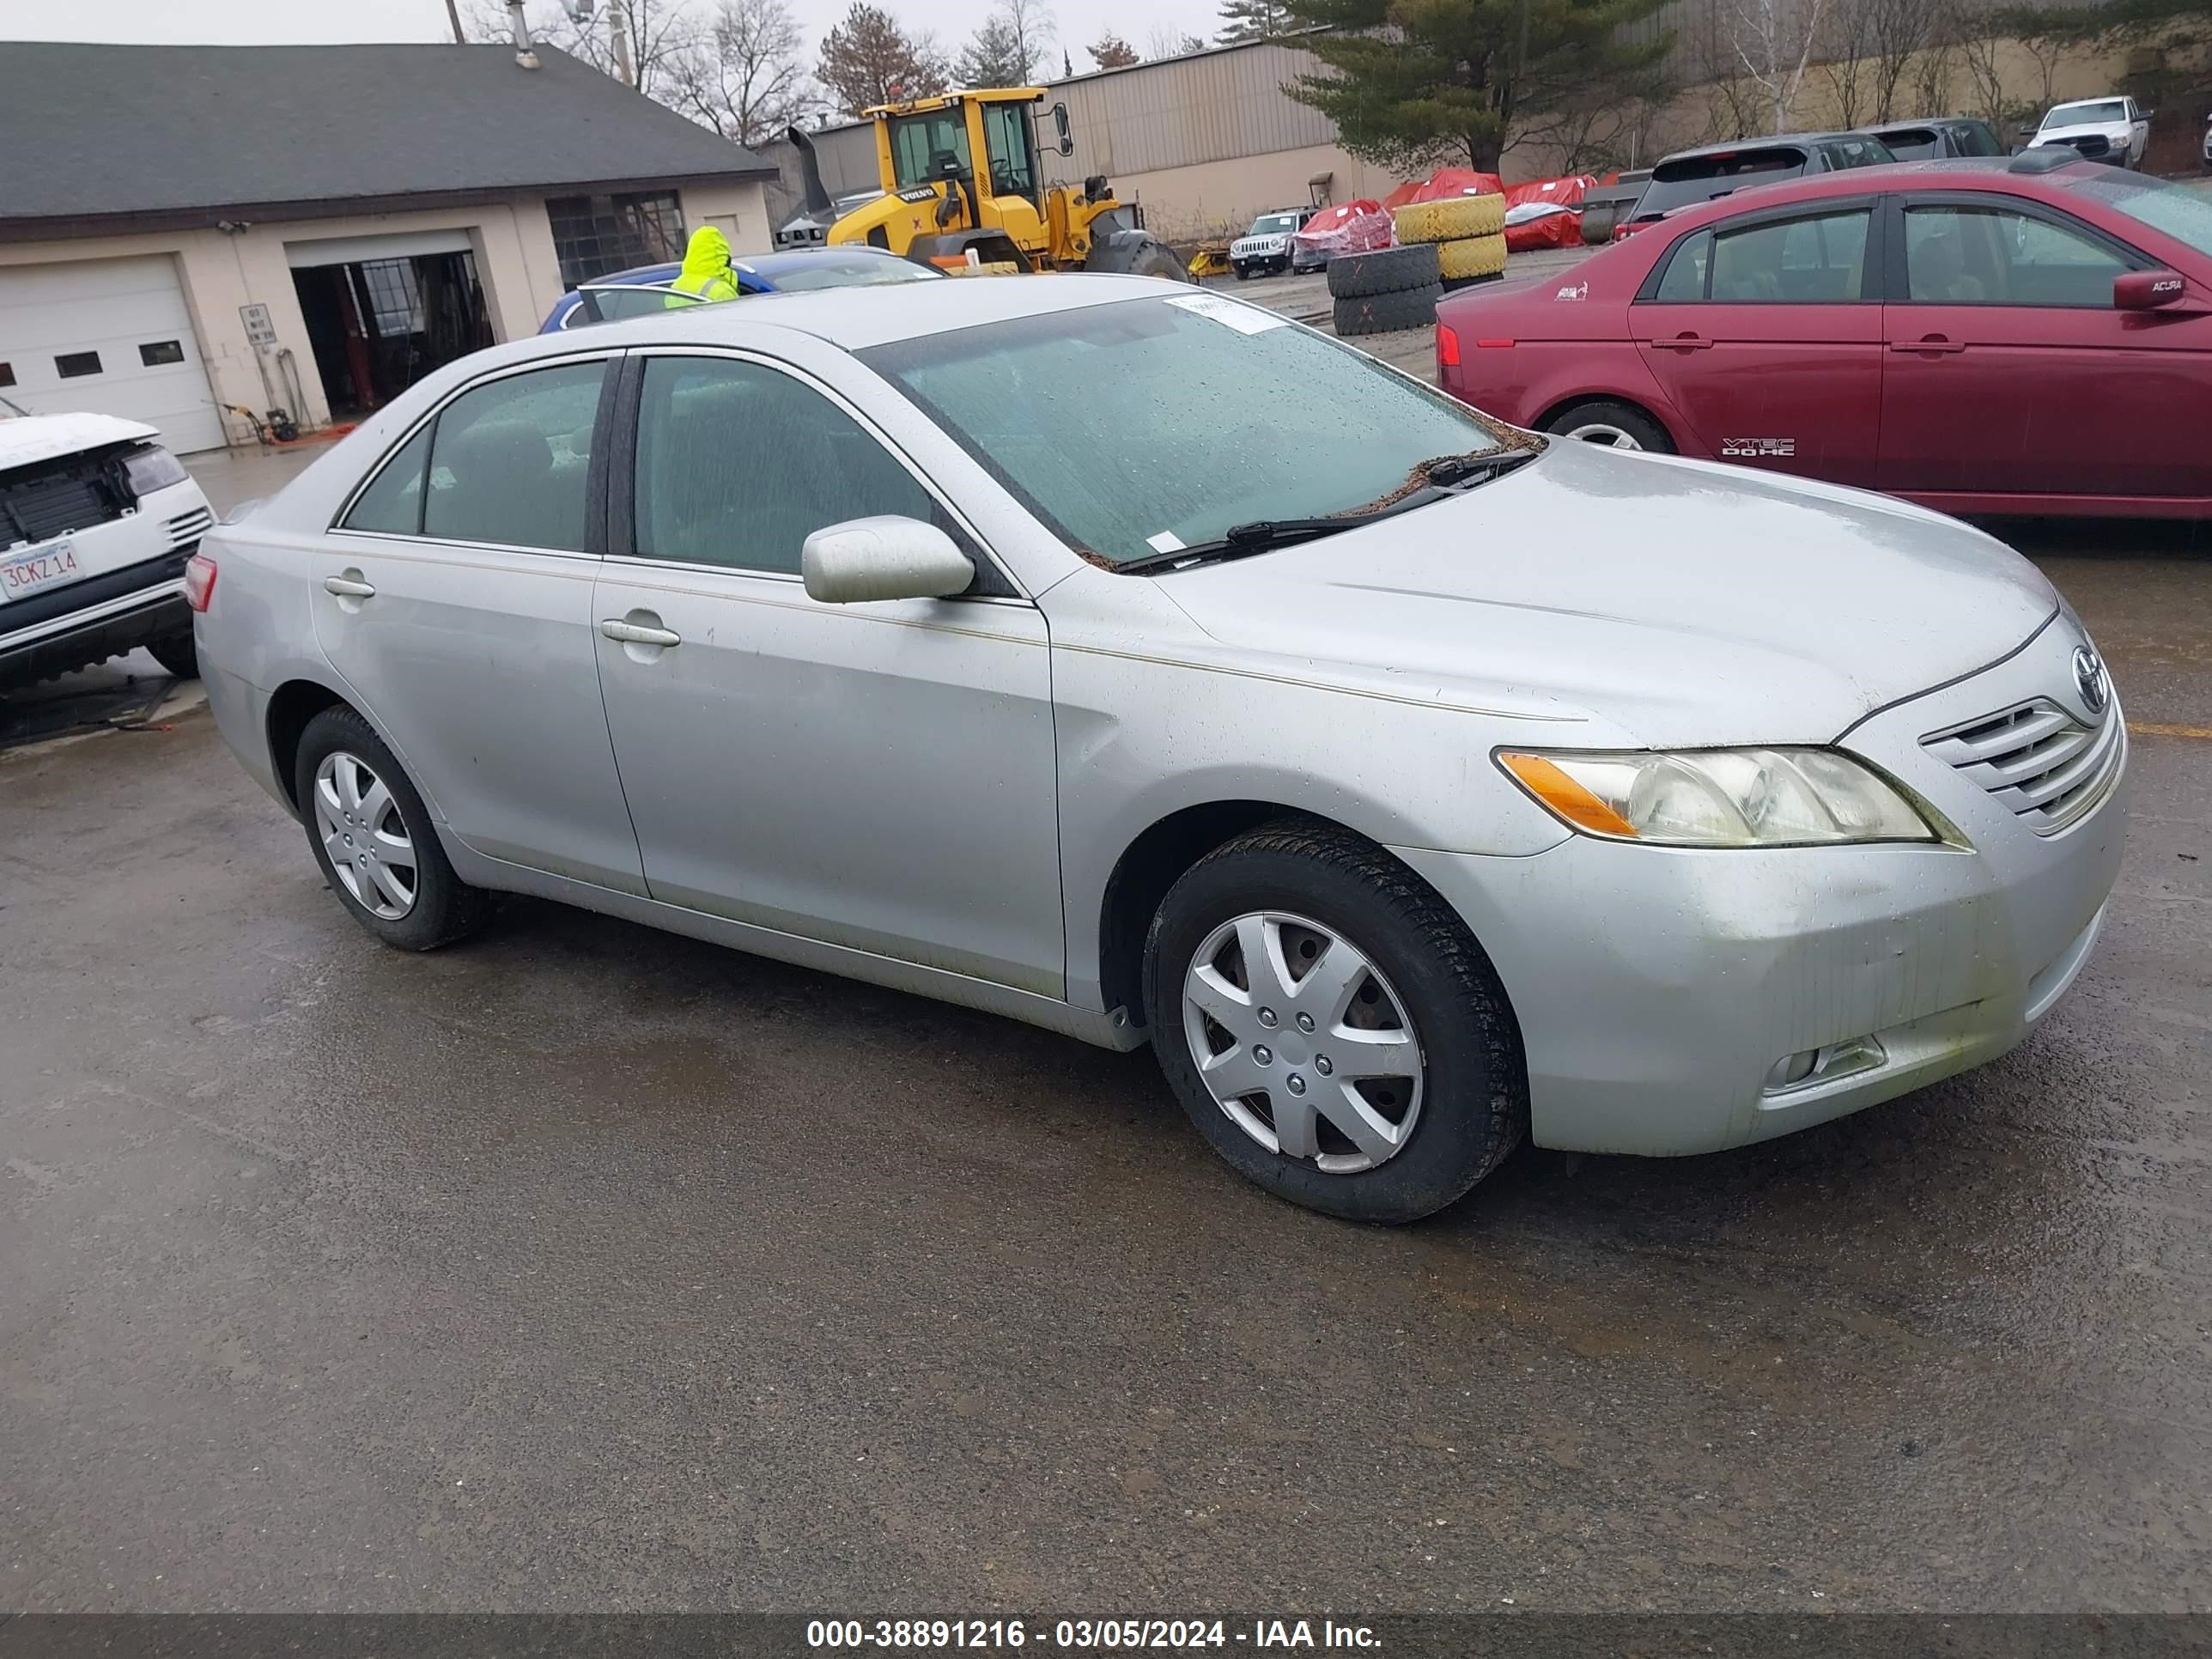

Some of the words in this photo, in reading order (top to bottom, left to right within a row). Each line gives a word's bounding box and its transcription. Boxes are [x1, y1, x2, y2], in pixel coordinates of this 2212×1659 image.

[900, 188, 934, 201] VOLVO
[2152, 280, 2182, 292] ACURA
[1723, 438, 1795, 449] VTEC
[1722, 447, 1795, 456] DOHC
[53, 551, 77, 574] 14
